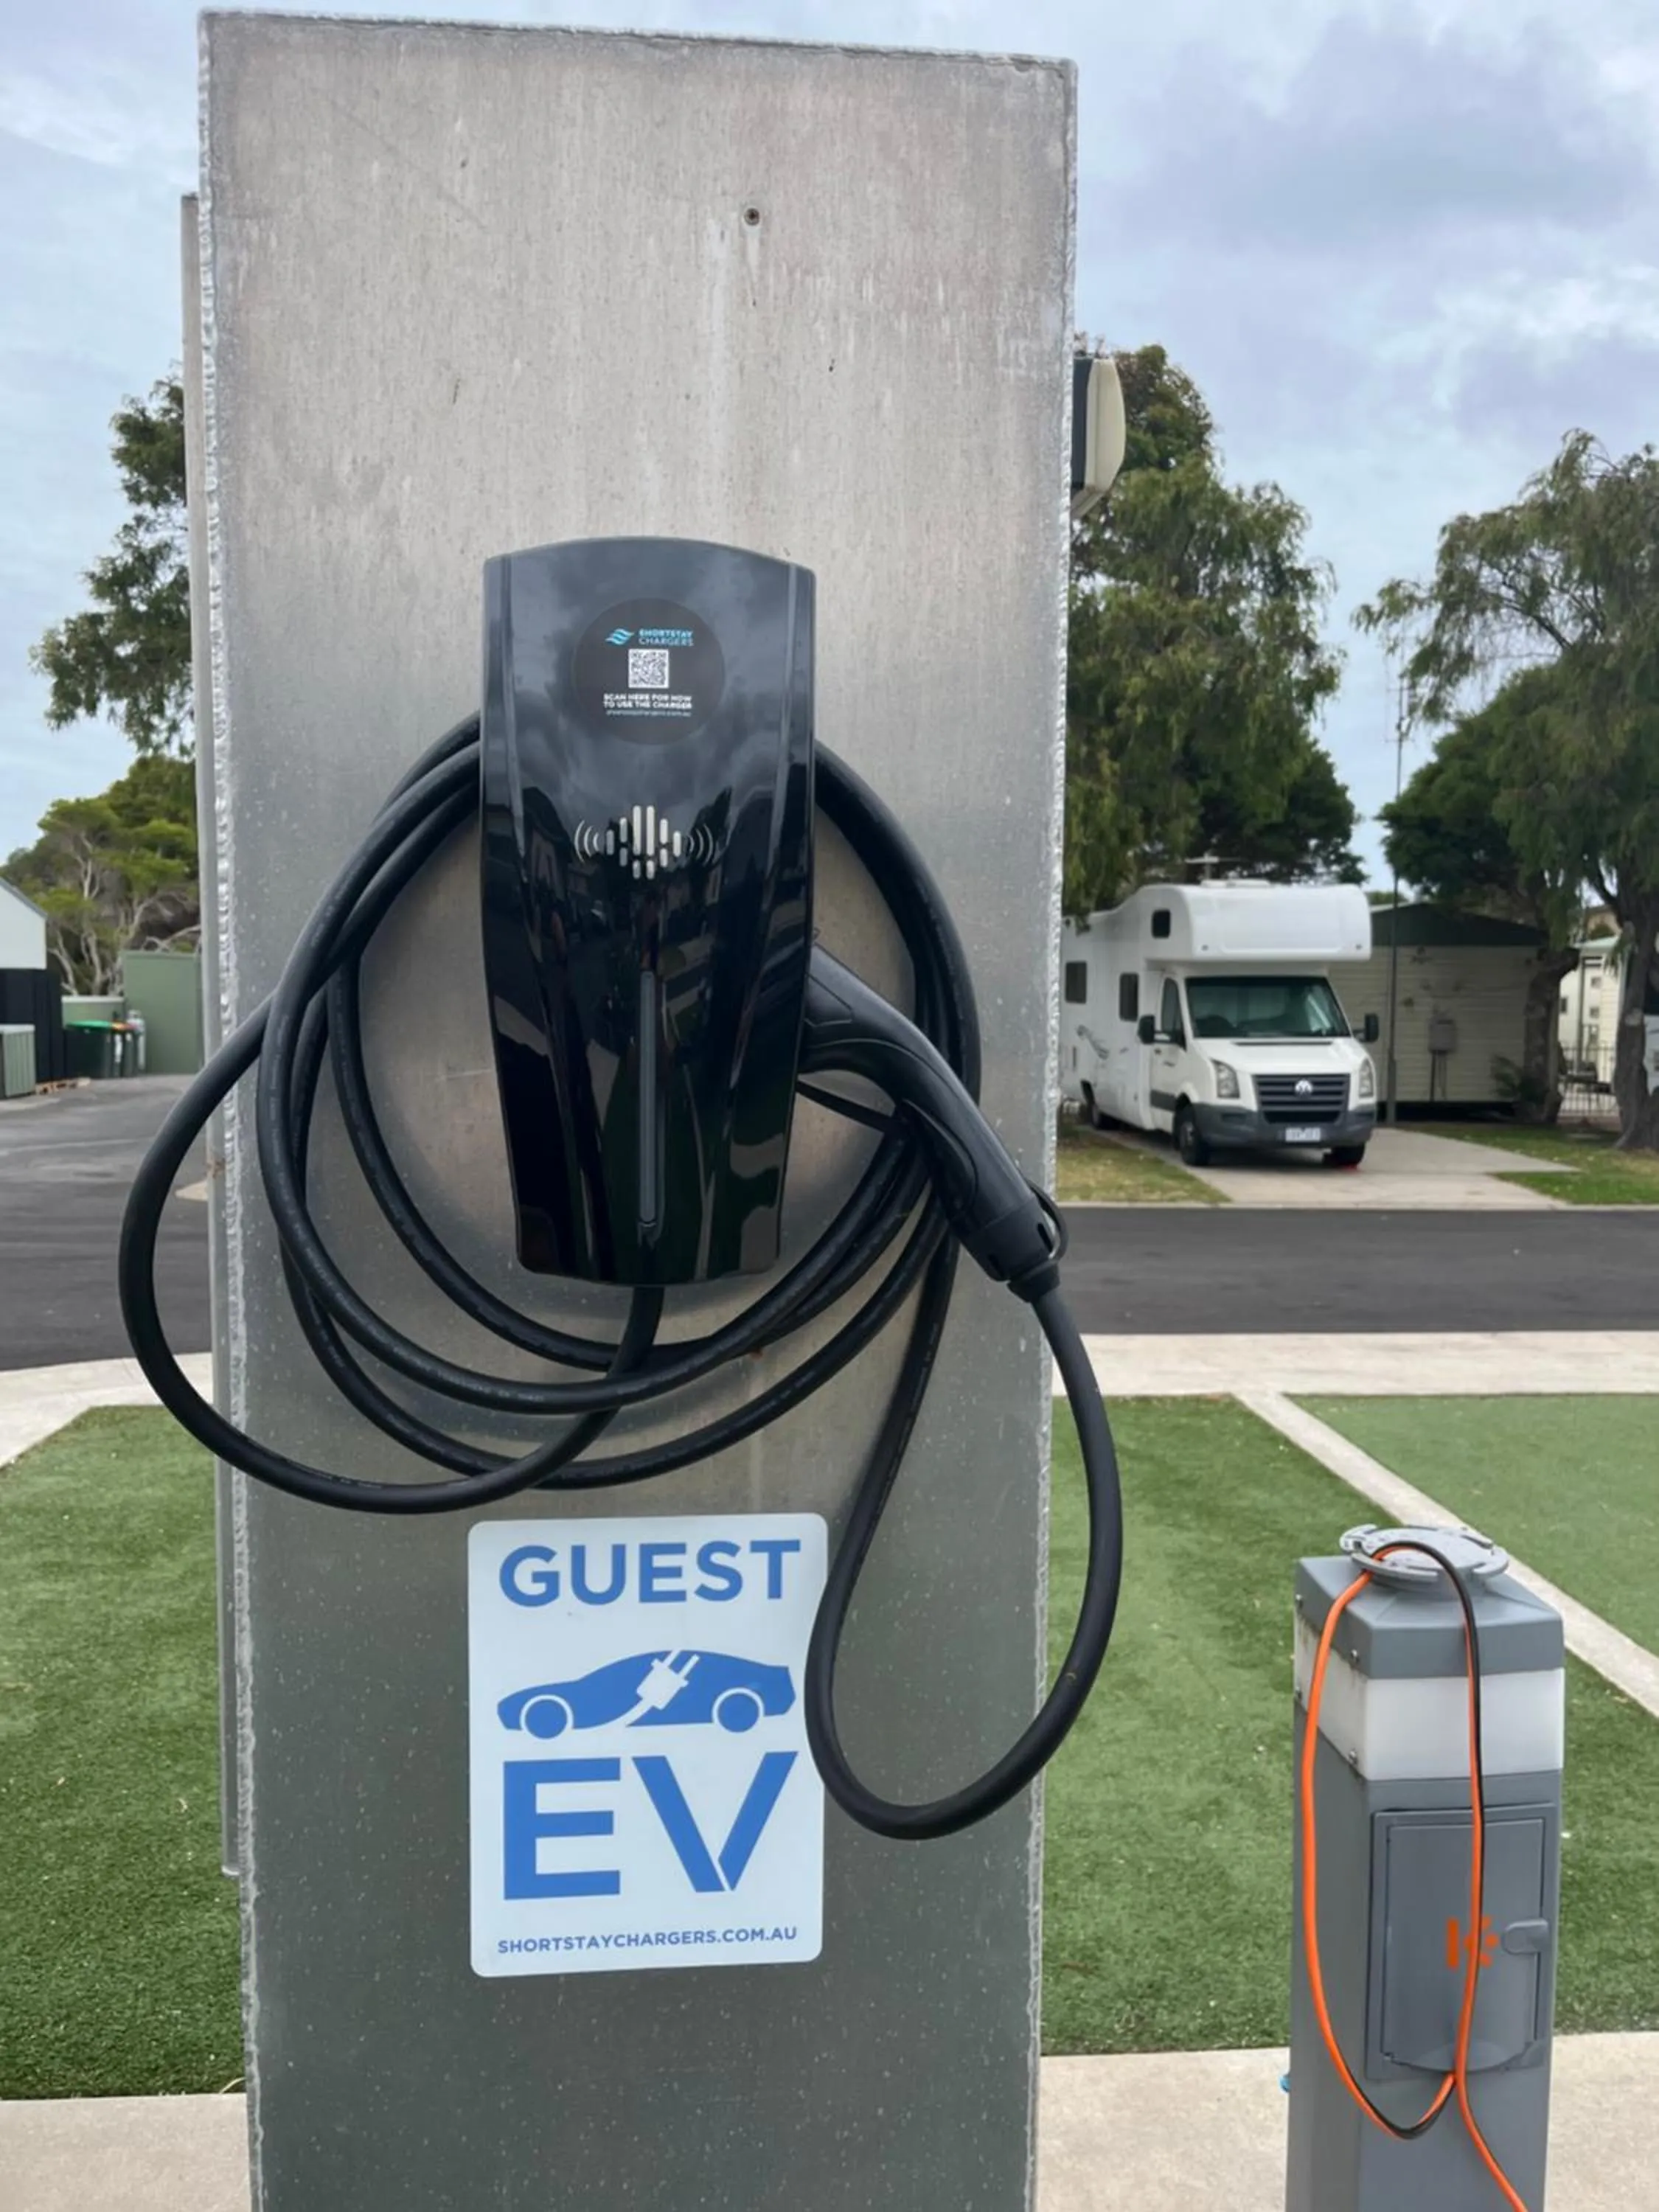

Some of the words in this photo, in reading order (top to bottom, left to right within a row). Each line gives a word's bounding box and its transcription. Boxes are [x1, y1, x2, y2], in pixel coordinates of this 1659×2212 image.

[499, 1540, 801, 1607] GUEST
[504, 1750, 799, 1901] EV
[497, 1927, 798, 1955] SHORTSTAYCHARGERS.COM.AU
